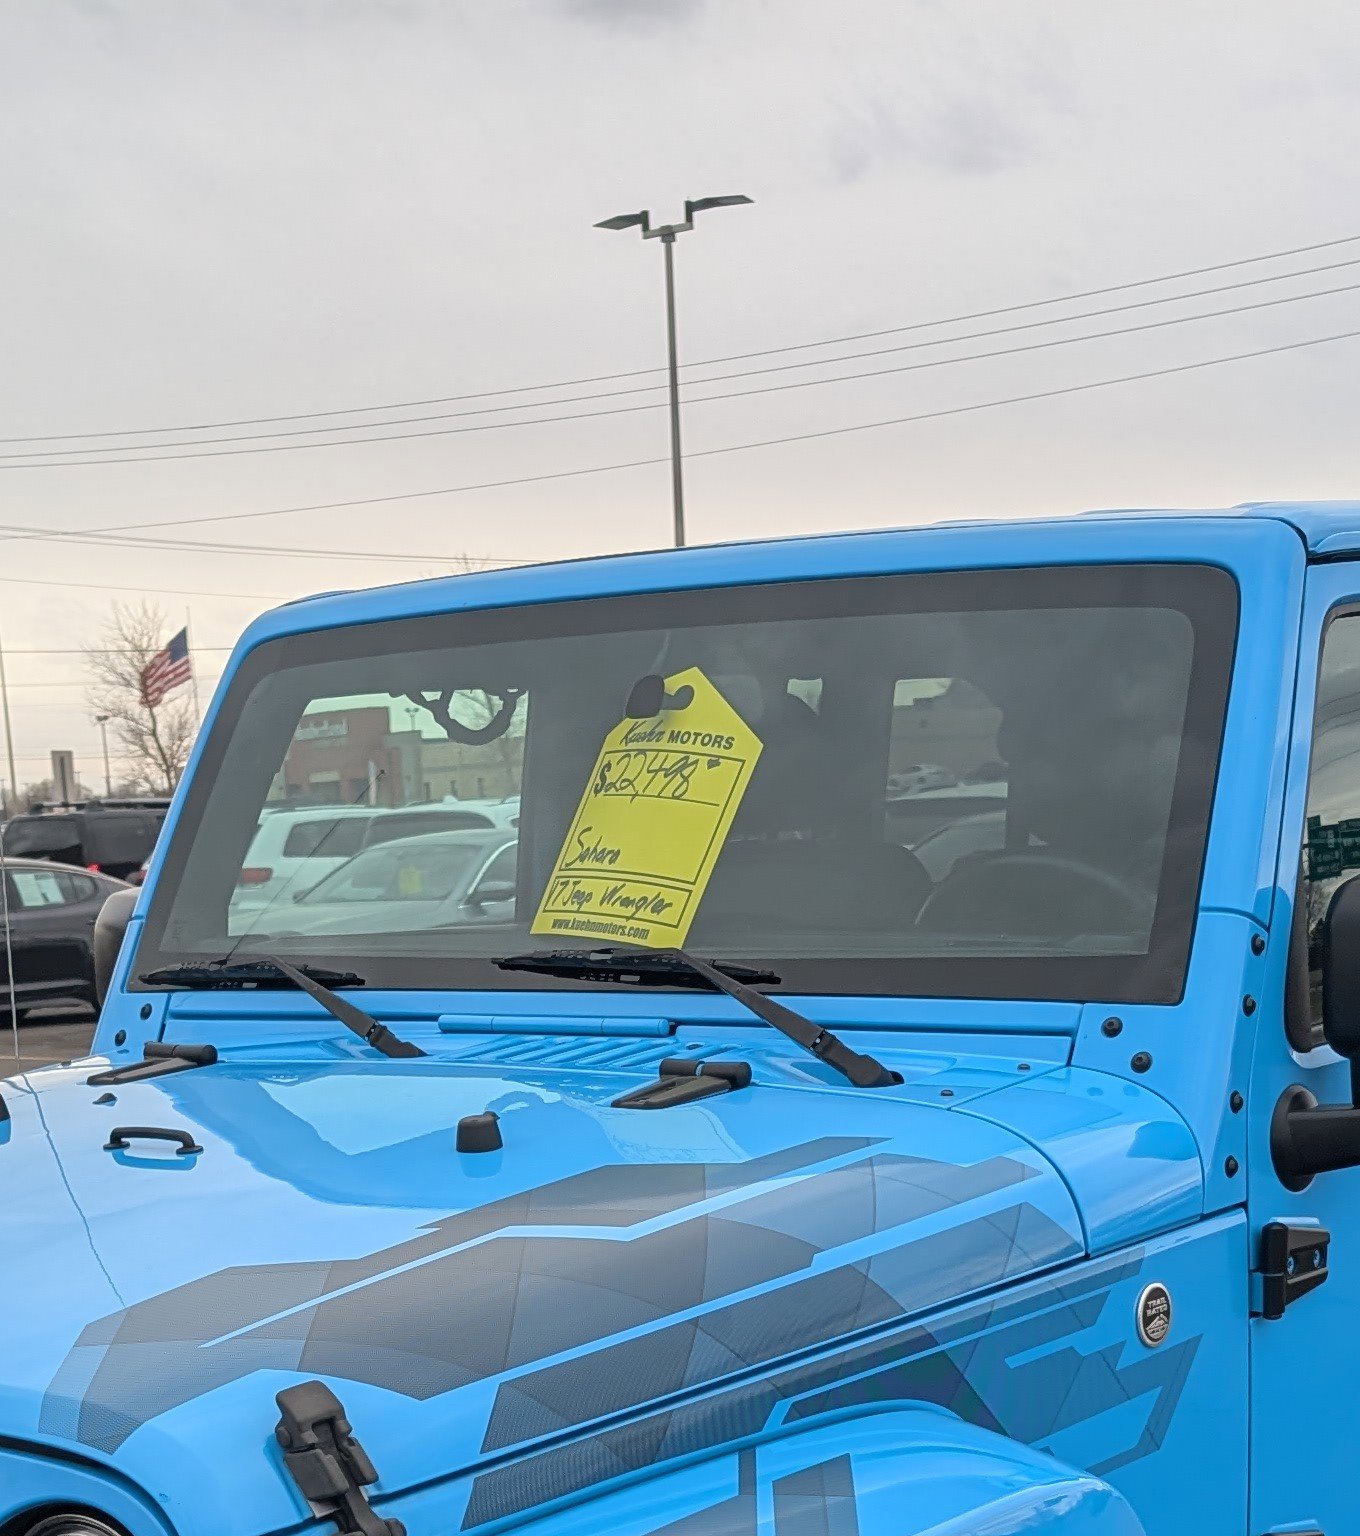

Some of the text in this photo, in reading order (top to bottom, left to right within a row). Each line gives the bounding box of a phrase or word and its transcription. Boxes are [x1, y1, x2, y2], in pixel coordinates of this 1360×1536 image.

[666, 729, 736, 750] MOTORS
[562, 880, 594, 911] Jeep
[598, 883, 674, 922] Wrangler
